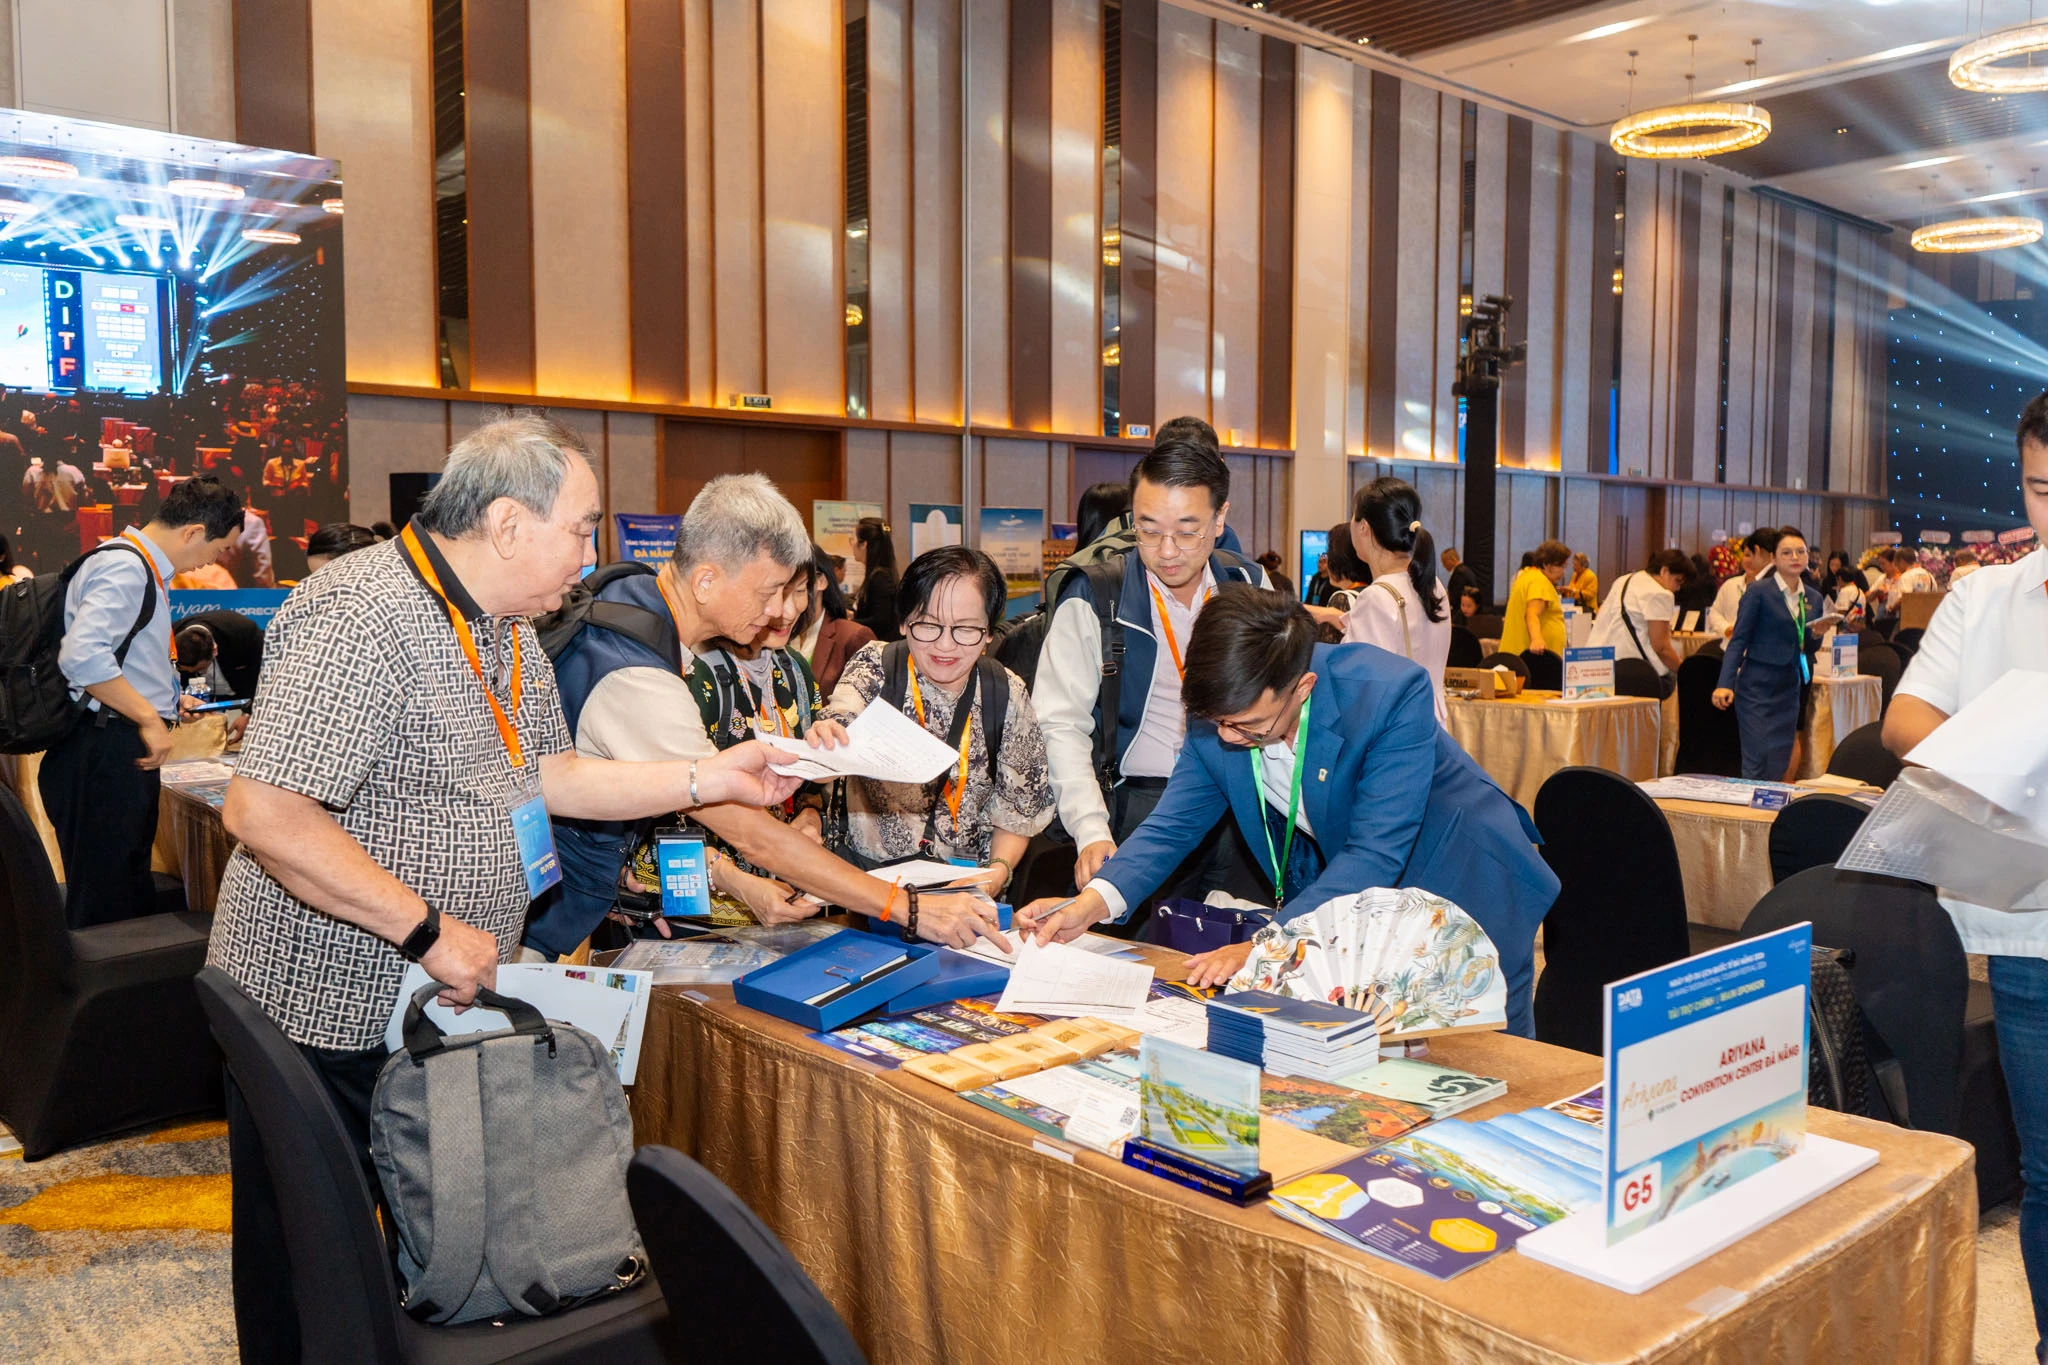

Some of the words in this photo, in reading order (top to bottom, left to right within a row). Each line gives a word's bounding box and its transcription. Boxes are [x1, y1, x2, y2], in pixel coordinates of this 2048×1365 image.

[55, 280, 76, 377] DITF
[527, 851, 554, 872] INTERNATIONAL
[540, 859, 556, 875] BUYER
[1737, 979, 1764, 995] SPONSOR
[1719, 1036, 1766, 1067] ARIYANA
[1680, 1071, 1734, 1102] CONVENTION
[1735, 1059, 1763, 1080] CENTER
[1765, 1053, 1776, 1068] ĐÀ
[1778, 1043, 1800, 1063] NẴNG
[1154, 1159, 1187, 1178] CONVENTION
[1624, 1174, 1652, 1211] G5
